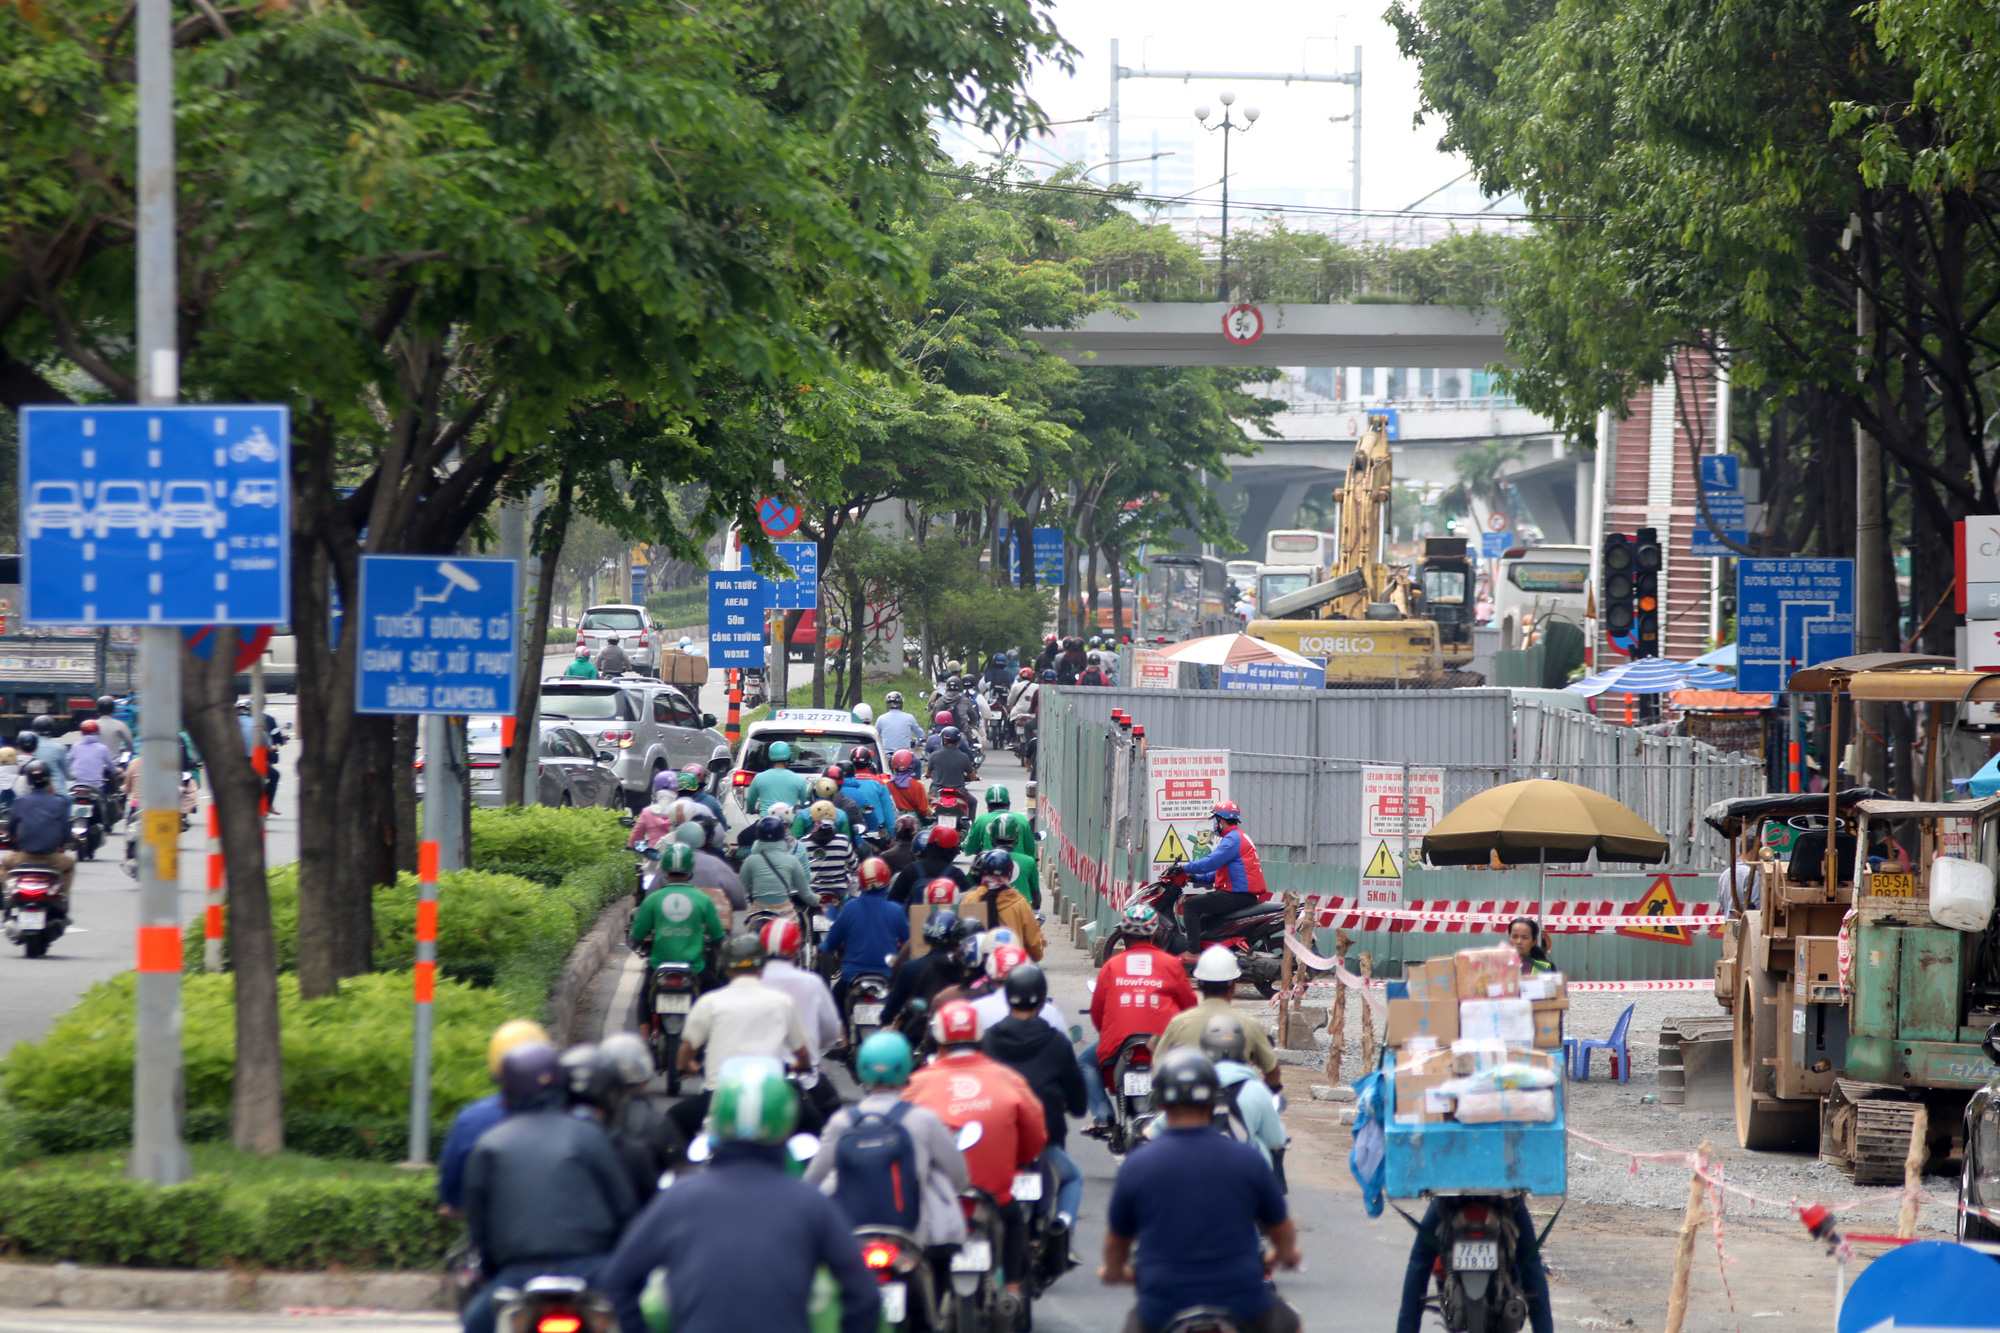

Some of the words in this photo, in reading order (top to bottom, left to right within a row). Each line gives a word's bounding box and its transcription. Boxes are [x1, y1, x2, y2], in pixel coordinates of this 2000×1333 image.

[715, 580, 732, 590] PHÍA
[734, 579, 757, 590] TRƯỚC
[725, 598, 749, 606] AHEAD
[374, 612, 424, 638] TUYẾN
[429, 610, 483, 639] ĐƯỜNG
[487, 611, 510, 640] CÓ
[727, 615, 745, 625] 50m
[712, 632, 731, 641] CÔNG
[733, 631, 761, 642] TRƯỜNG
[1299, 636, 1375, 653] KOBELCO
[474, 652, 512, 679] PHẠT
[1295, 671, 1307, 679] NY
[386, 675, 428, 707] BẰNG
[433, 686, 497, 709] CAMERA
[1766, 828, 1790, 846] Cô
[1873, 875, 1909, 888] 50-SA
[1367, 890, 1396, 903] 5Km/h
[1116, 978, 1162, 988] NowFood
